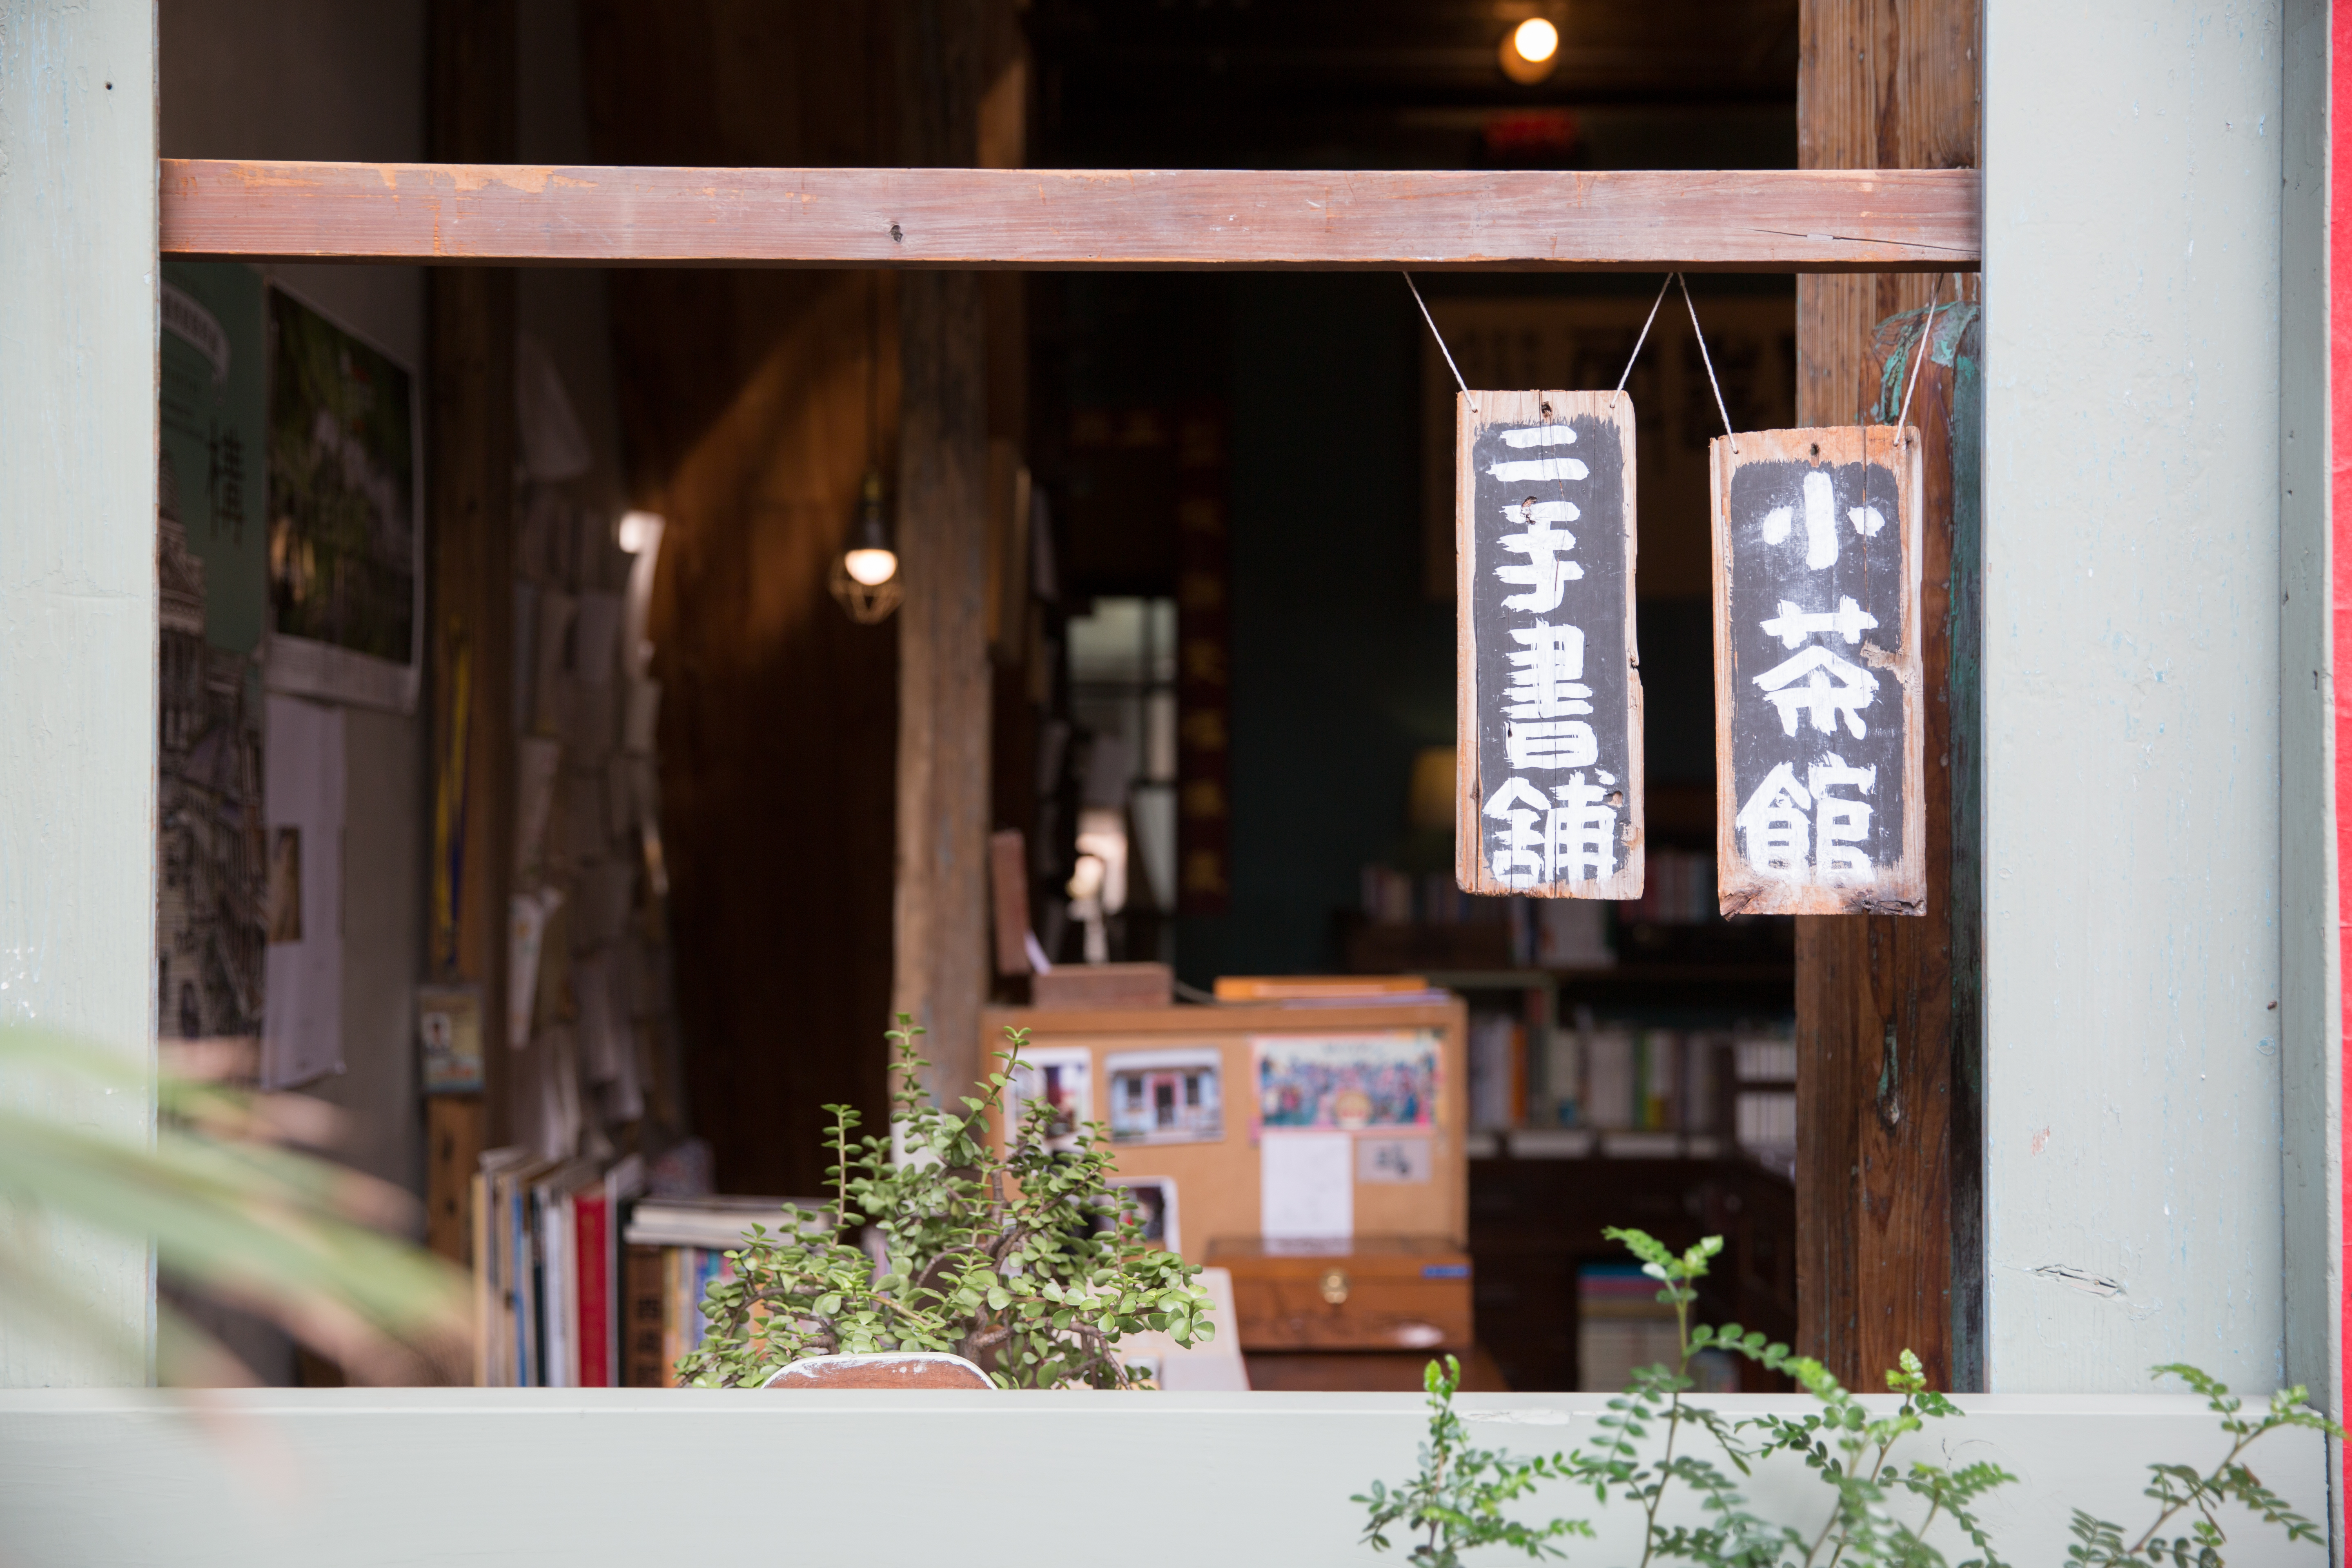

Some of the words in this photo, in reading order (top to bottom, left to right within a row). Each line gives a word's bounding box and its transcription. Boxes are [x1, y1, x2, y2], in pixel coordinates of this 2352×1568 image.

[1481, 425, 1619, 889] 二手書舖
[1735, 470, 1886, 884] 小茶館
